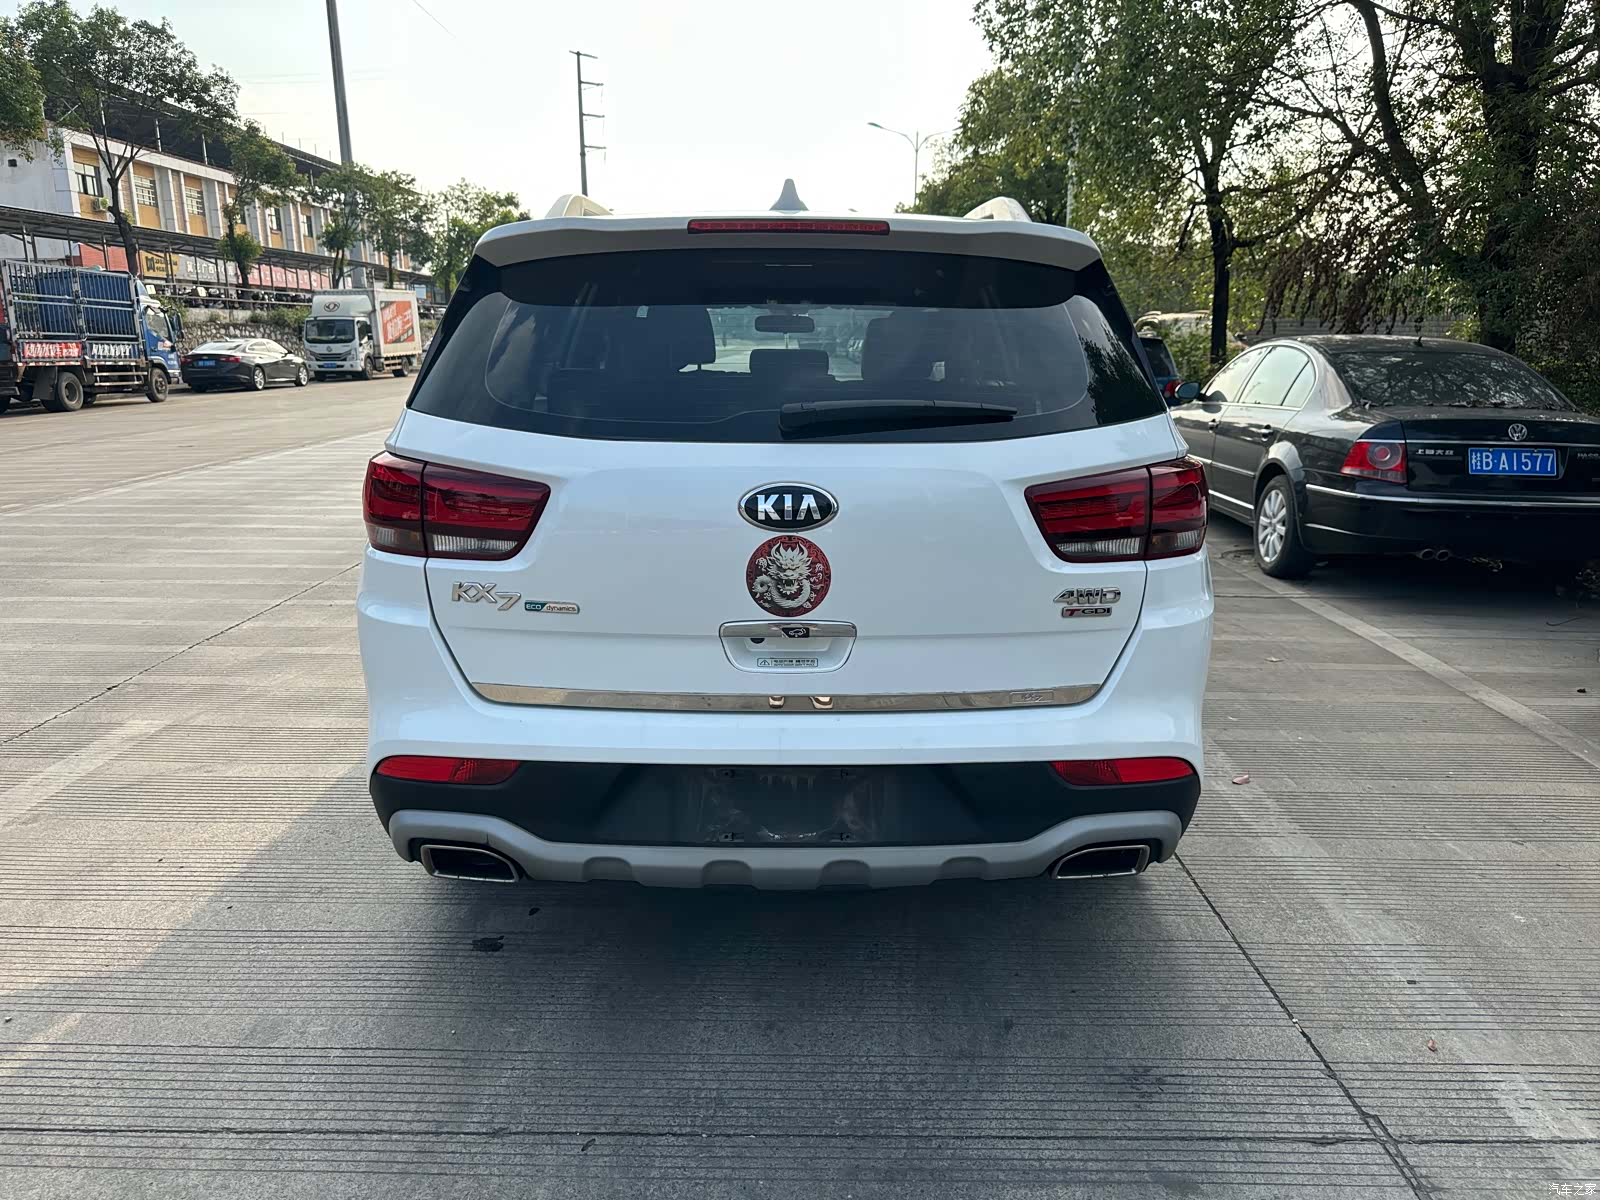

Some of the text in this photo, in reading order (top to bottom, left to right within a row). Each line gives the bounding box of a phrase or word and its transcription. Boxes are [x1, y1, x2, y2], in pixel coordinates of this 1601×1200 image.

[756, 494, 822, 521] KIA
[451, 581, 522, 611] KX7
[1053, 587, 1122, 605] 4WD
[546, 605, 577, 613] dynamics
